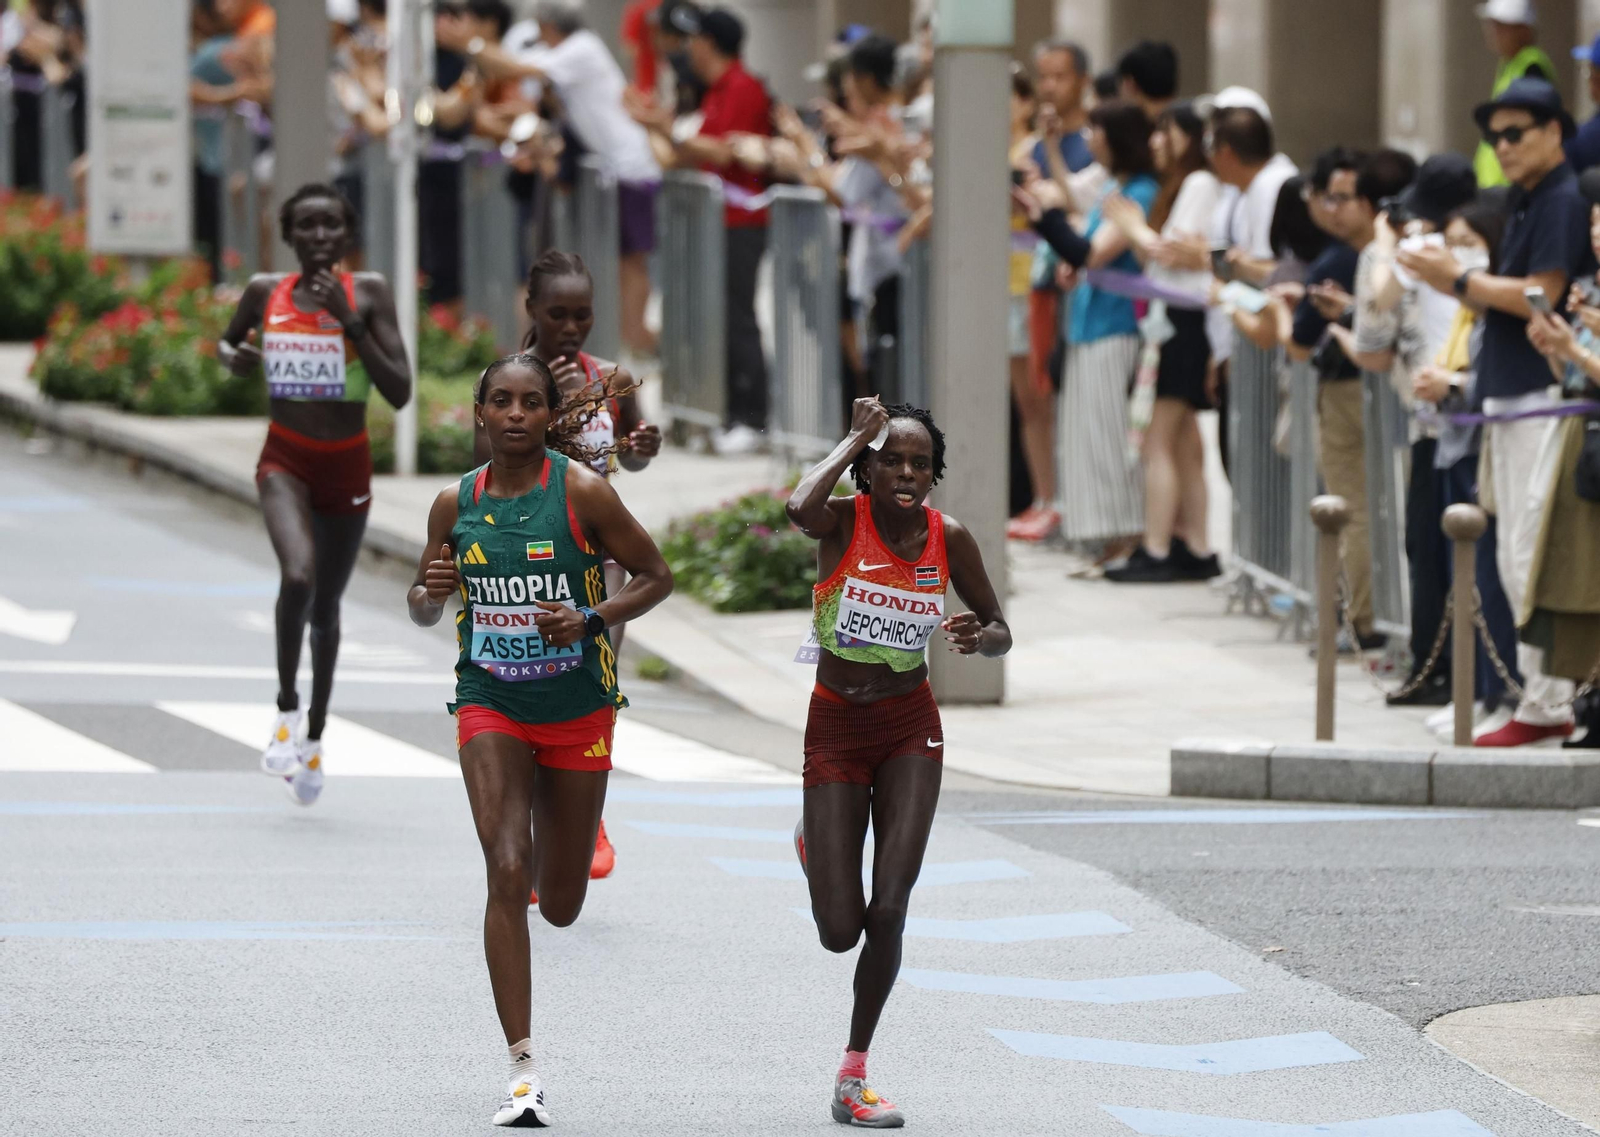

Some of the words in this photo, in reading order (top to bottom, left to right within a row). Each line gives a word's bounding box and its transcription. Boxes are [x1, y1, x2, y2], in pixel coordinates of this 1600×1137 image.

[465, 573, 571, 603] ETHIOPIA
[844, 585, 941, 616] HONDA
[474, 611, 551, 627] HON
